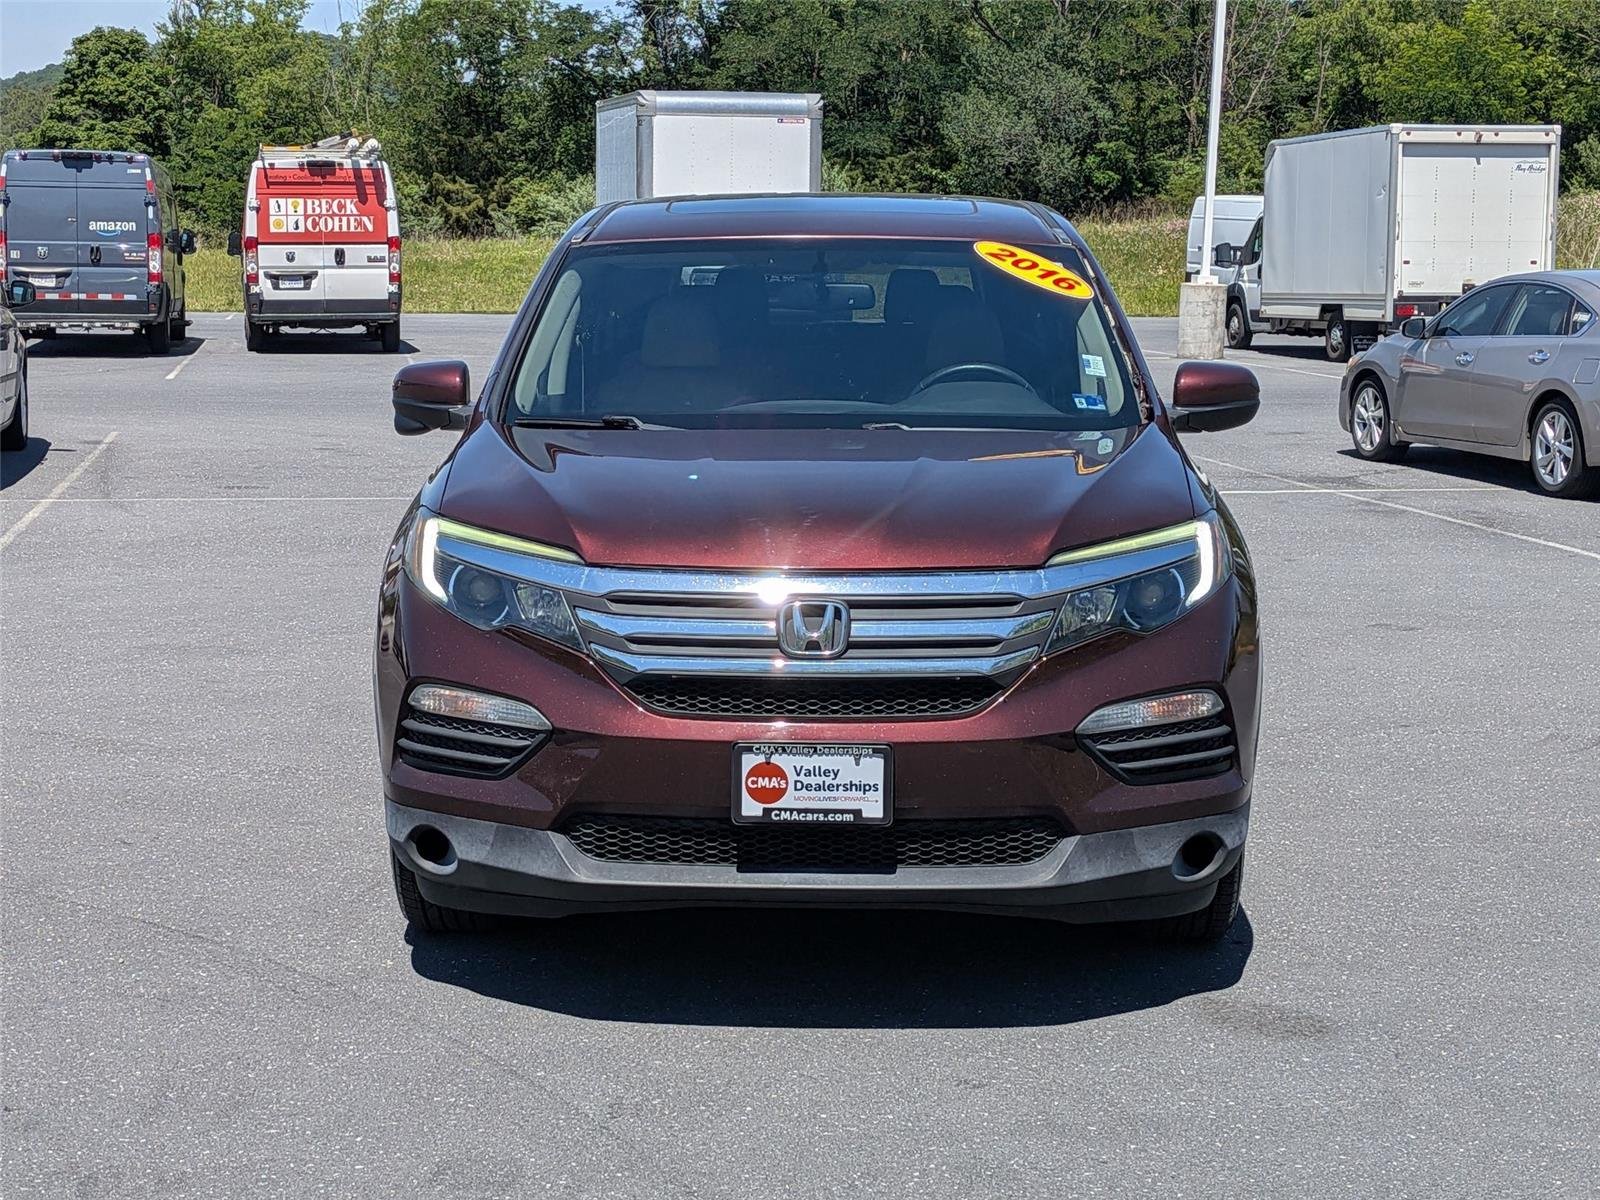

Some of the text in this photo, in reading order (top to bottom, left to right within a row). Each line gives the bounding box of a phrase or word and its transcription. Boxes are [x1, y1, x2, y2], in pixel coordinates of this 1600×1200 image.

[306, 198, 360, 215] BECK
[89, 221, 136, 231] amazon
[306, 216, 374, 233] COHEN
[986, 248, 1081, 291] 2016
[752, 745, 873, 755] CMA's Valley Dealerships
[793, 765, 840, 780] Valley
[747, 777, 786, 789] CMA's
[794, 780, 879, 795] Dealerships
[771, 811, 854, 822] CMAcars.com
